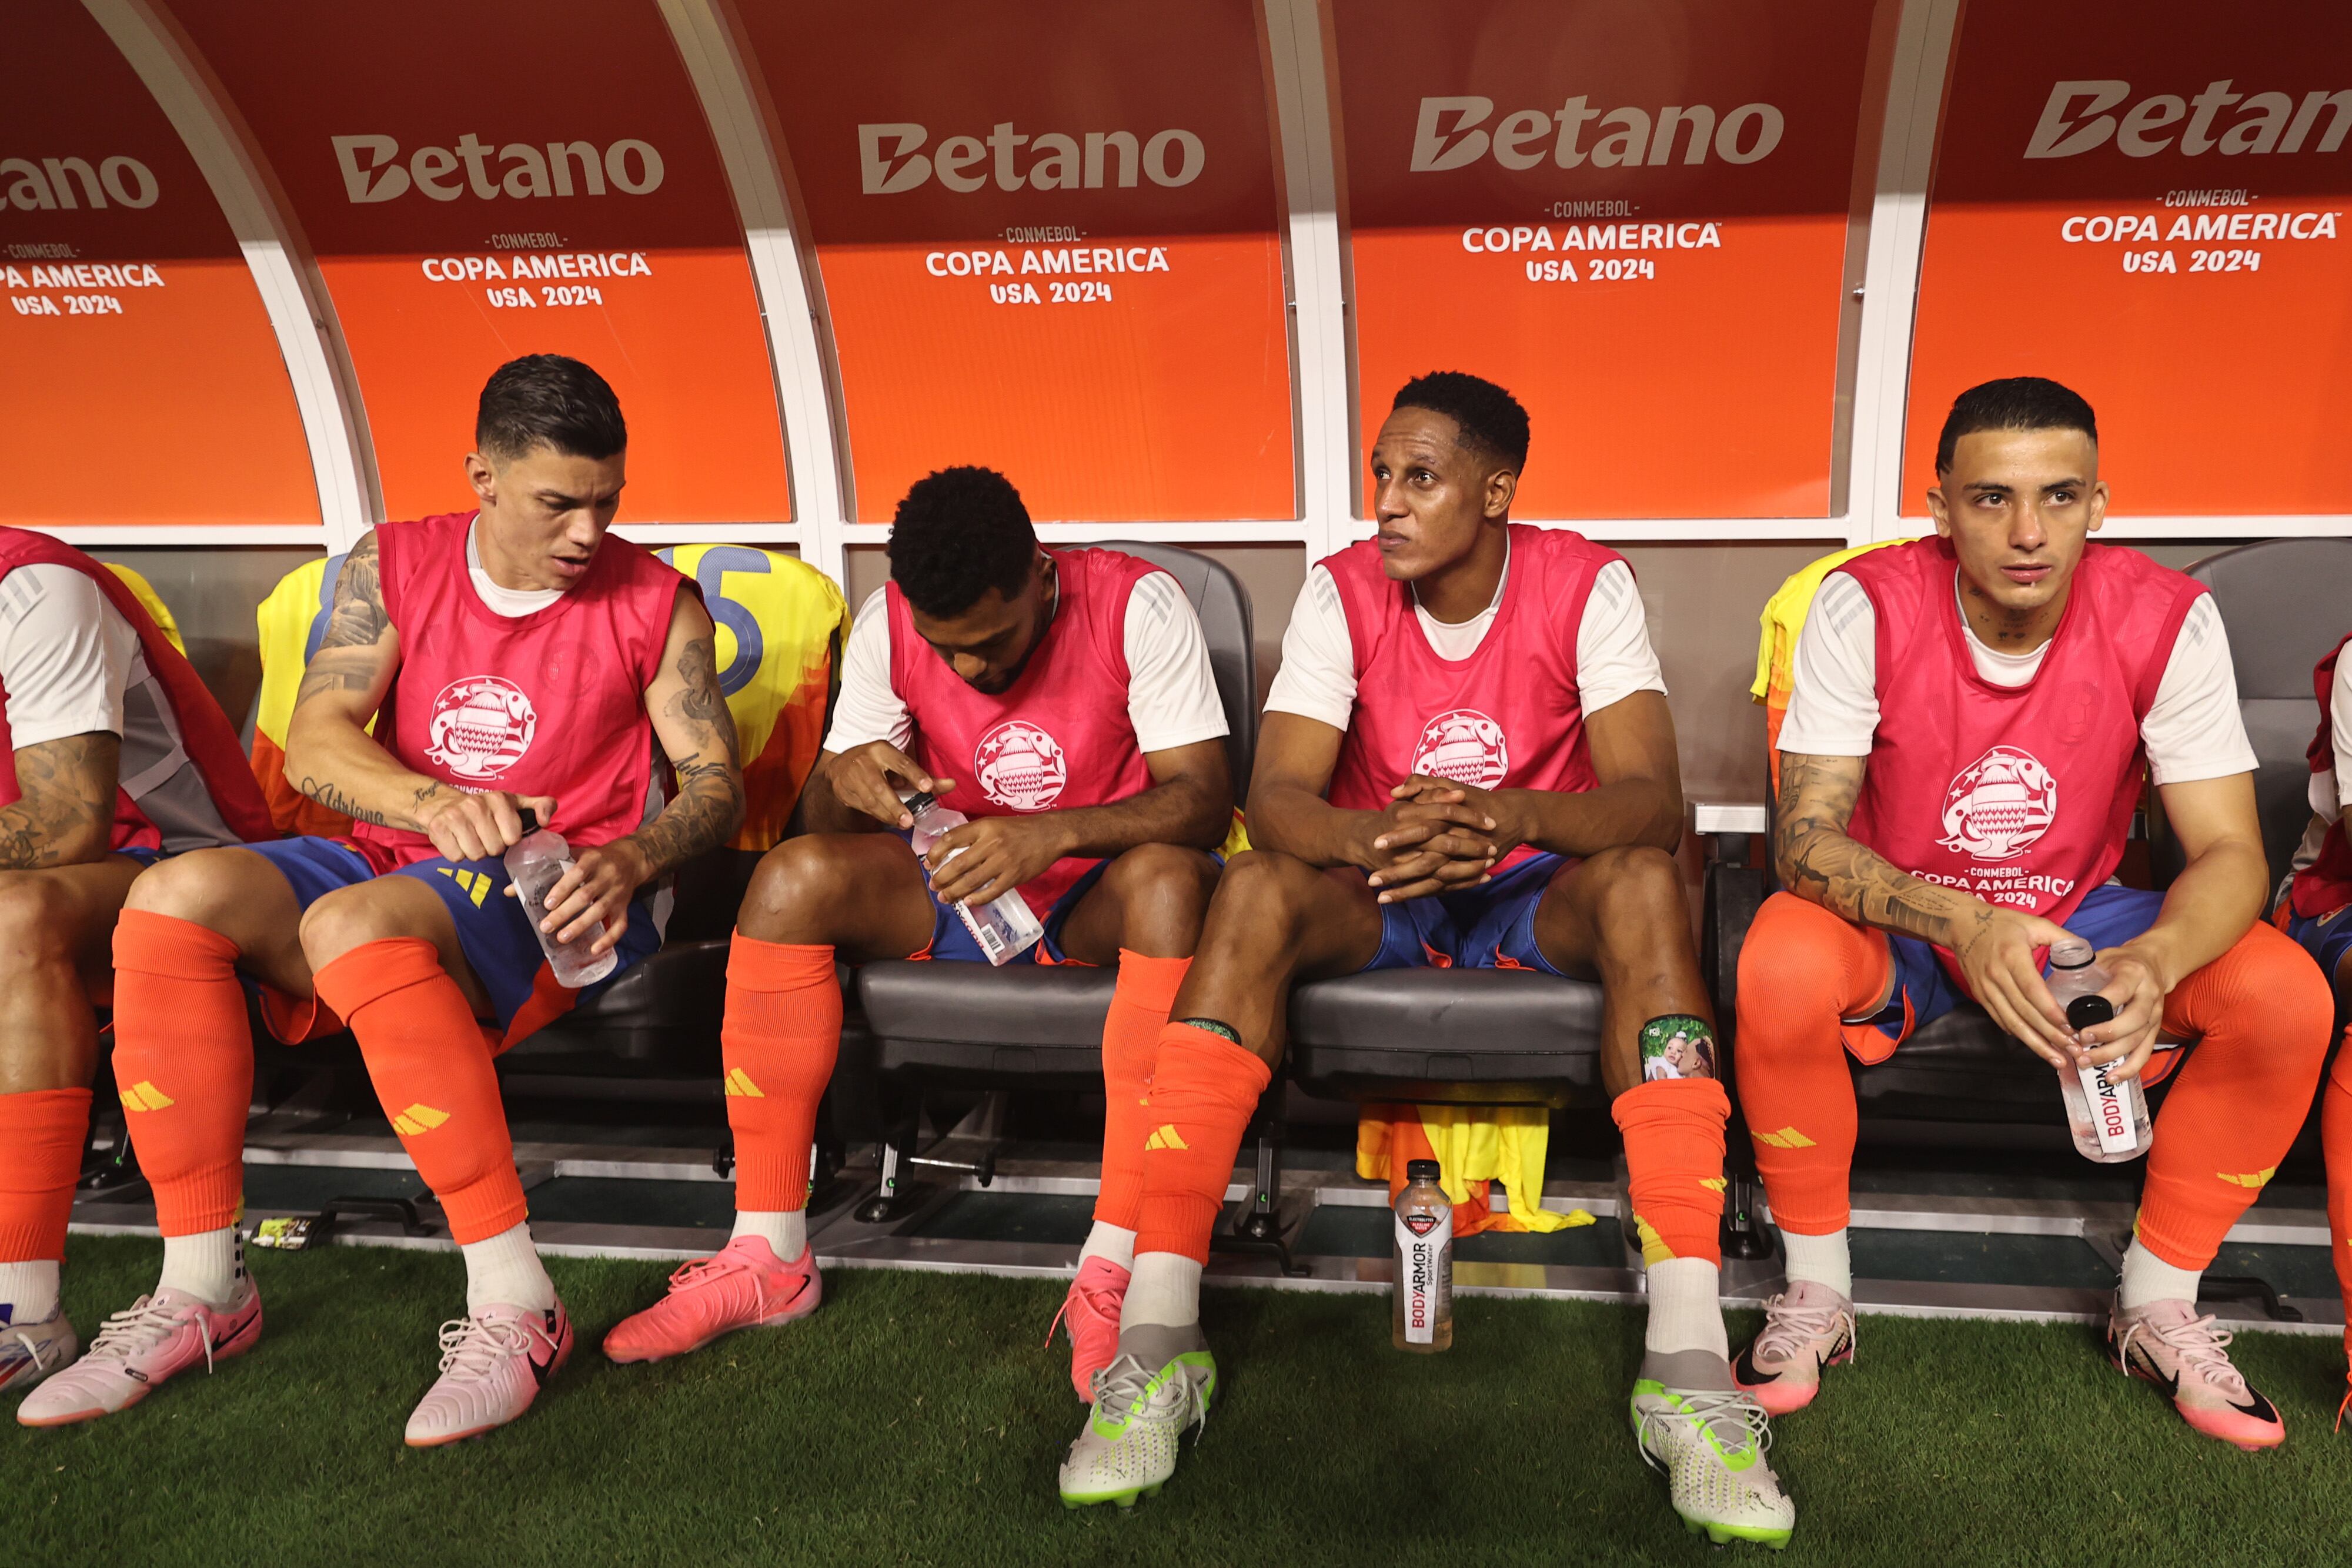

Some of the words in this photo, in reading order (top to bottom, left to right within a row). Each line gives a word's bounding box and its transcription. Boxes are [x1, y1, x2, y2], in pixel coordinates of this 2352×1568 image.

[1409, 95, 1784, 172] Betano
[330, 133, 664, 204] Betano
[858, 122, 1205, 195] Betano
[0, 155, 159, 211] ano
[1553, 200, 1632, 218] CONMEBOL
[2164, 189, 2249, 208] CONMEBOL
[1005, 226, 1081, 243] CONMEBOL
[1462, 226, 1555, 253] COPA
[1561, 222, 1721, 250] AMERICA
[2061, 215, 2159, 242] COPA
[2165, 212, 2337, 241] AMERICA
[492, 232, 564, 249] CONMEBOL
[421, 257, 507, 282] COPA
[512, 252, 653, 280] AMERICA
[926, 250, 1015, 276] COPA
[1020, 247, 1170, 275] AMERICA
[1526, 259, 1578, 282] USA
[1588, 258, 1654, 280] 2024
[2122, 250, 2177, 273] USA
[2188, 249, 2261, 272] 2024
[31, 263, 165, 288] AMERICA
[11, 296, 61, 316] USA
[62, 295, 123, 315] 2024
[486, 287, 537, 308] USA
[541, 285, 603, 306] 2024
[990, 283, 1041, 305] USA
[1048, 281, 1112, 303] 2024
[1910, 870, 1971, 890] COPA
[1975, 875, 2074, 897] AMERICA
[1970, 867, 2024, 878] CONMEBOL
[1993, 891, 2037, 909] 2024
[2091, 1044, 2124, 1137] BODYARM
[1412, 1242, 1426, 1329] BODYARMOR
